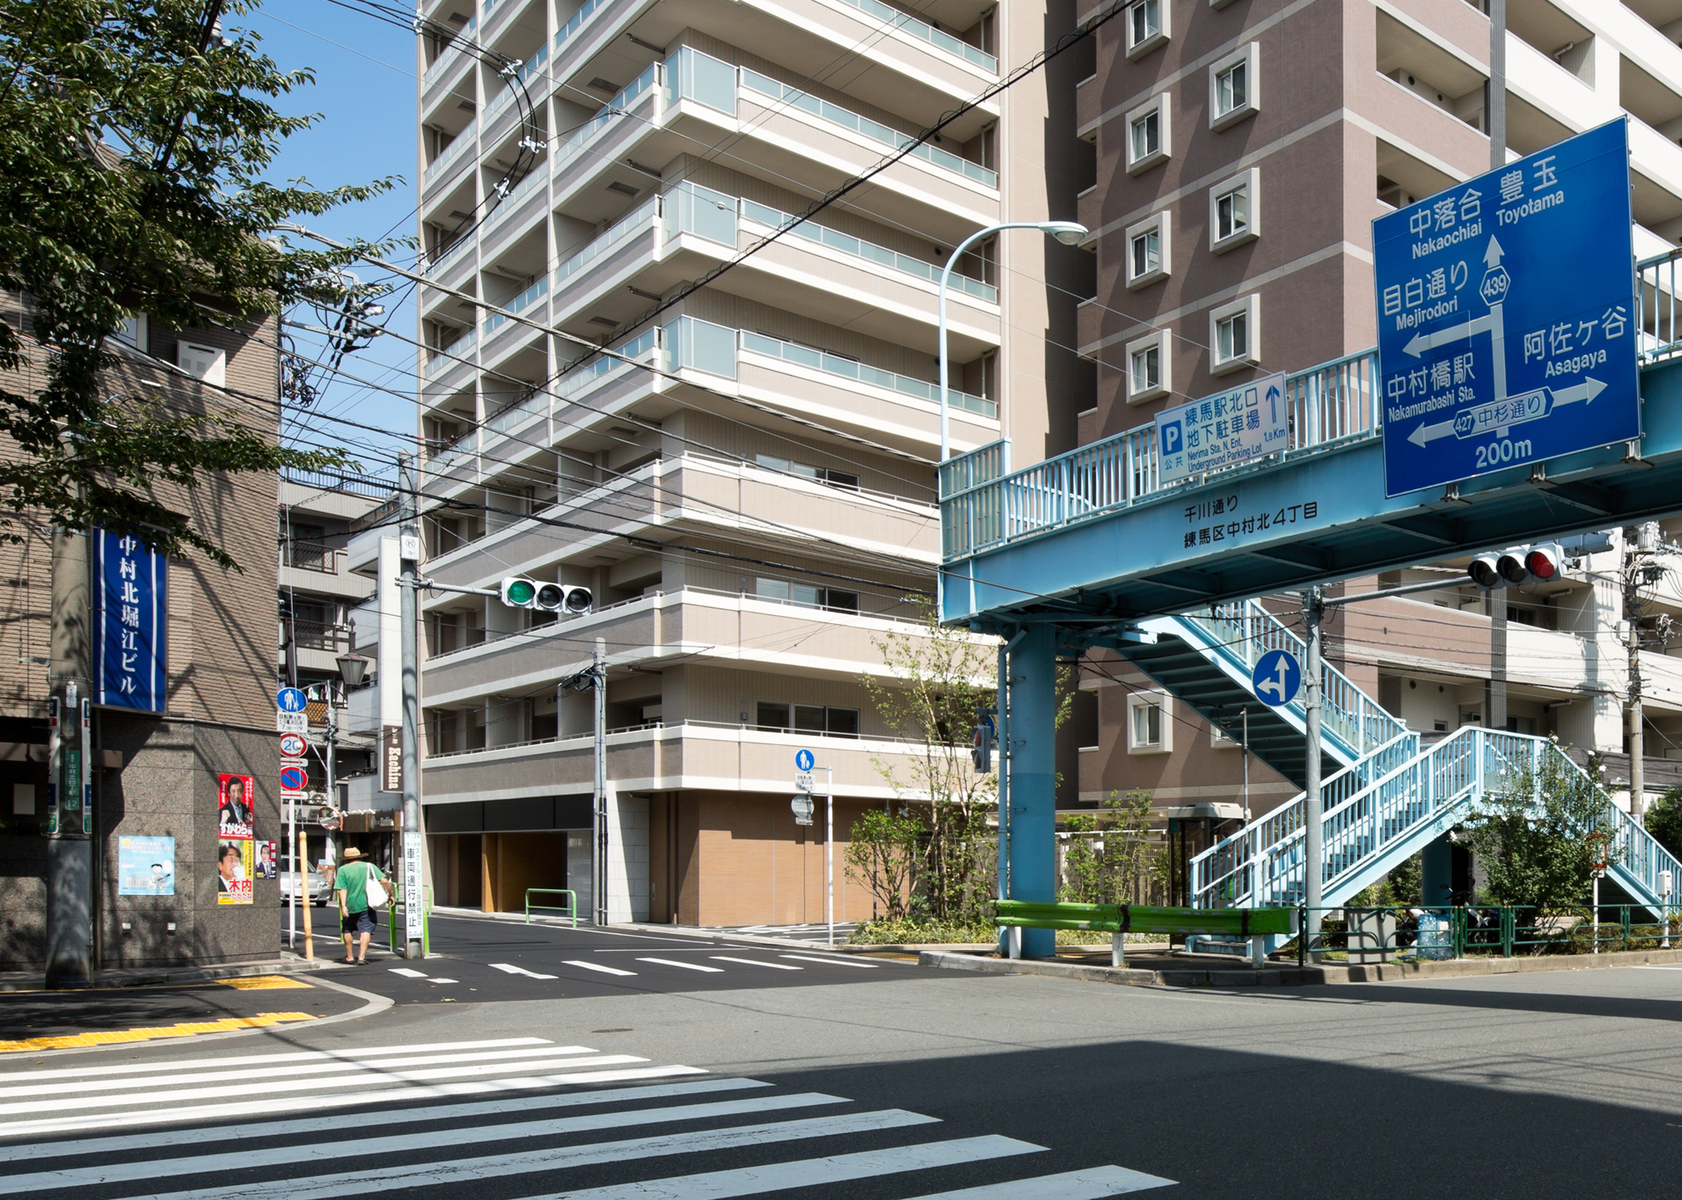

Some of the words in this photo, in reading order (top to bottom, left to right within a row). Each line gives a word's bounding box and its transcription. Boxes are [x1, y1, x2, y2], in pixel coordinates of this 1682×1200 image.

[1500, 155, 1557, 205] 豊玉
[1410, 188, 1482, 238] 中落合
[1496, 190, 1564, 226] Toyotama
[1412, 218, 1482, 259] Nakaochiai
[1384, 260, 1468, 316] 目白通り
[1483, 275, 1507, 297] 439
[1396, 295, 1458, 331] Mejirodori
[1387, 352, 1475, 403] 中村橋駅
[1545, 349, 1606, 378] Asagaya
[1185, 387, 1258, 427] 練馬駅北口
[1388, 389, 1455, 423] Nakamurabashi
[1458, 387, 1476, 403] Sta.
[1478, 395, 1541, 427] 中杉通り
[1165, 425, 1179, 452] P
[1187, 409, 1260, 449] 地下駐車場
[1455, 415, 1473, 433] 427
[1165, 455, 1183, 470] 公共
[1187, 448, 1209, 461] Nerima
[1210, 443, 1222, 455] Sta.
[1231, 438, 1242, 449] Ent.
[1188, 455, 1226, 473] Underground
[1227, 447, 1251, 461] Parking
[1252, 443, 1263, 455] Lot
[1475, 439, 1532, 469] 200m
[1184, 495, 1239, 523] 千川通り
[1184, 501, 1318, 549] 練馬区中村北4丁目
[119, 534, 140, 695] 中村北堀江ビル
[388, 747, 401, 789] Kachina
[228, 879, 252, 893] 木内
[407, 848, 417, 927] 車両通行禁止
